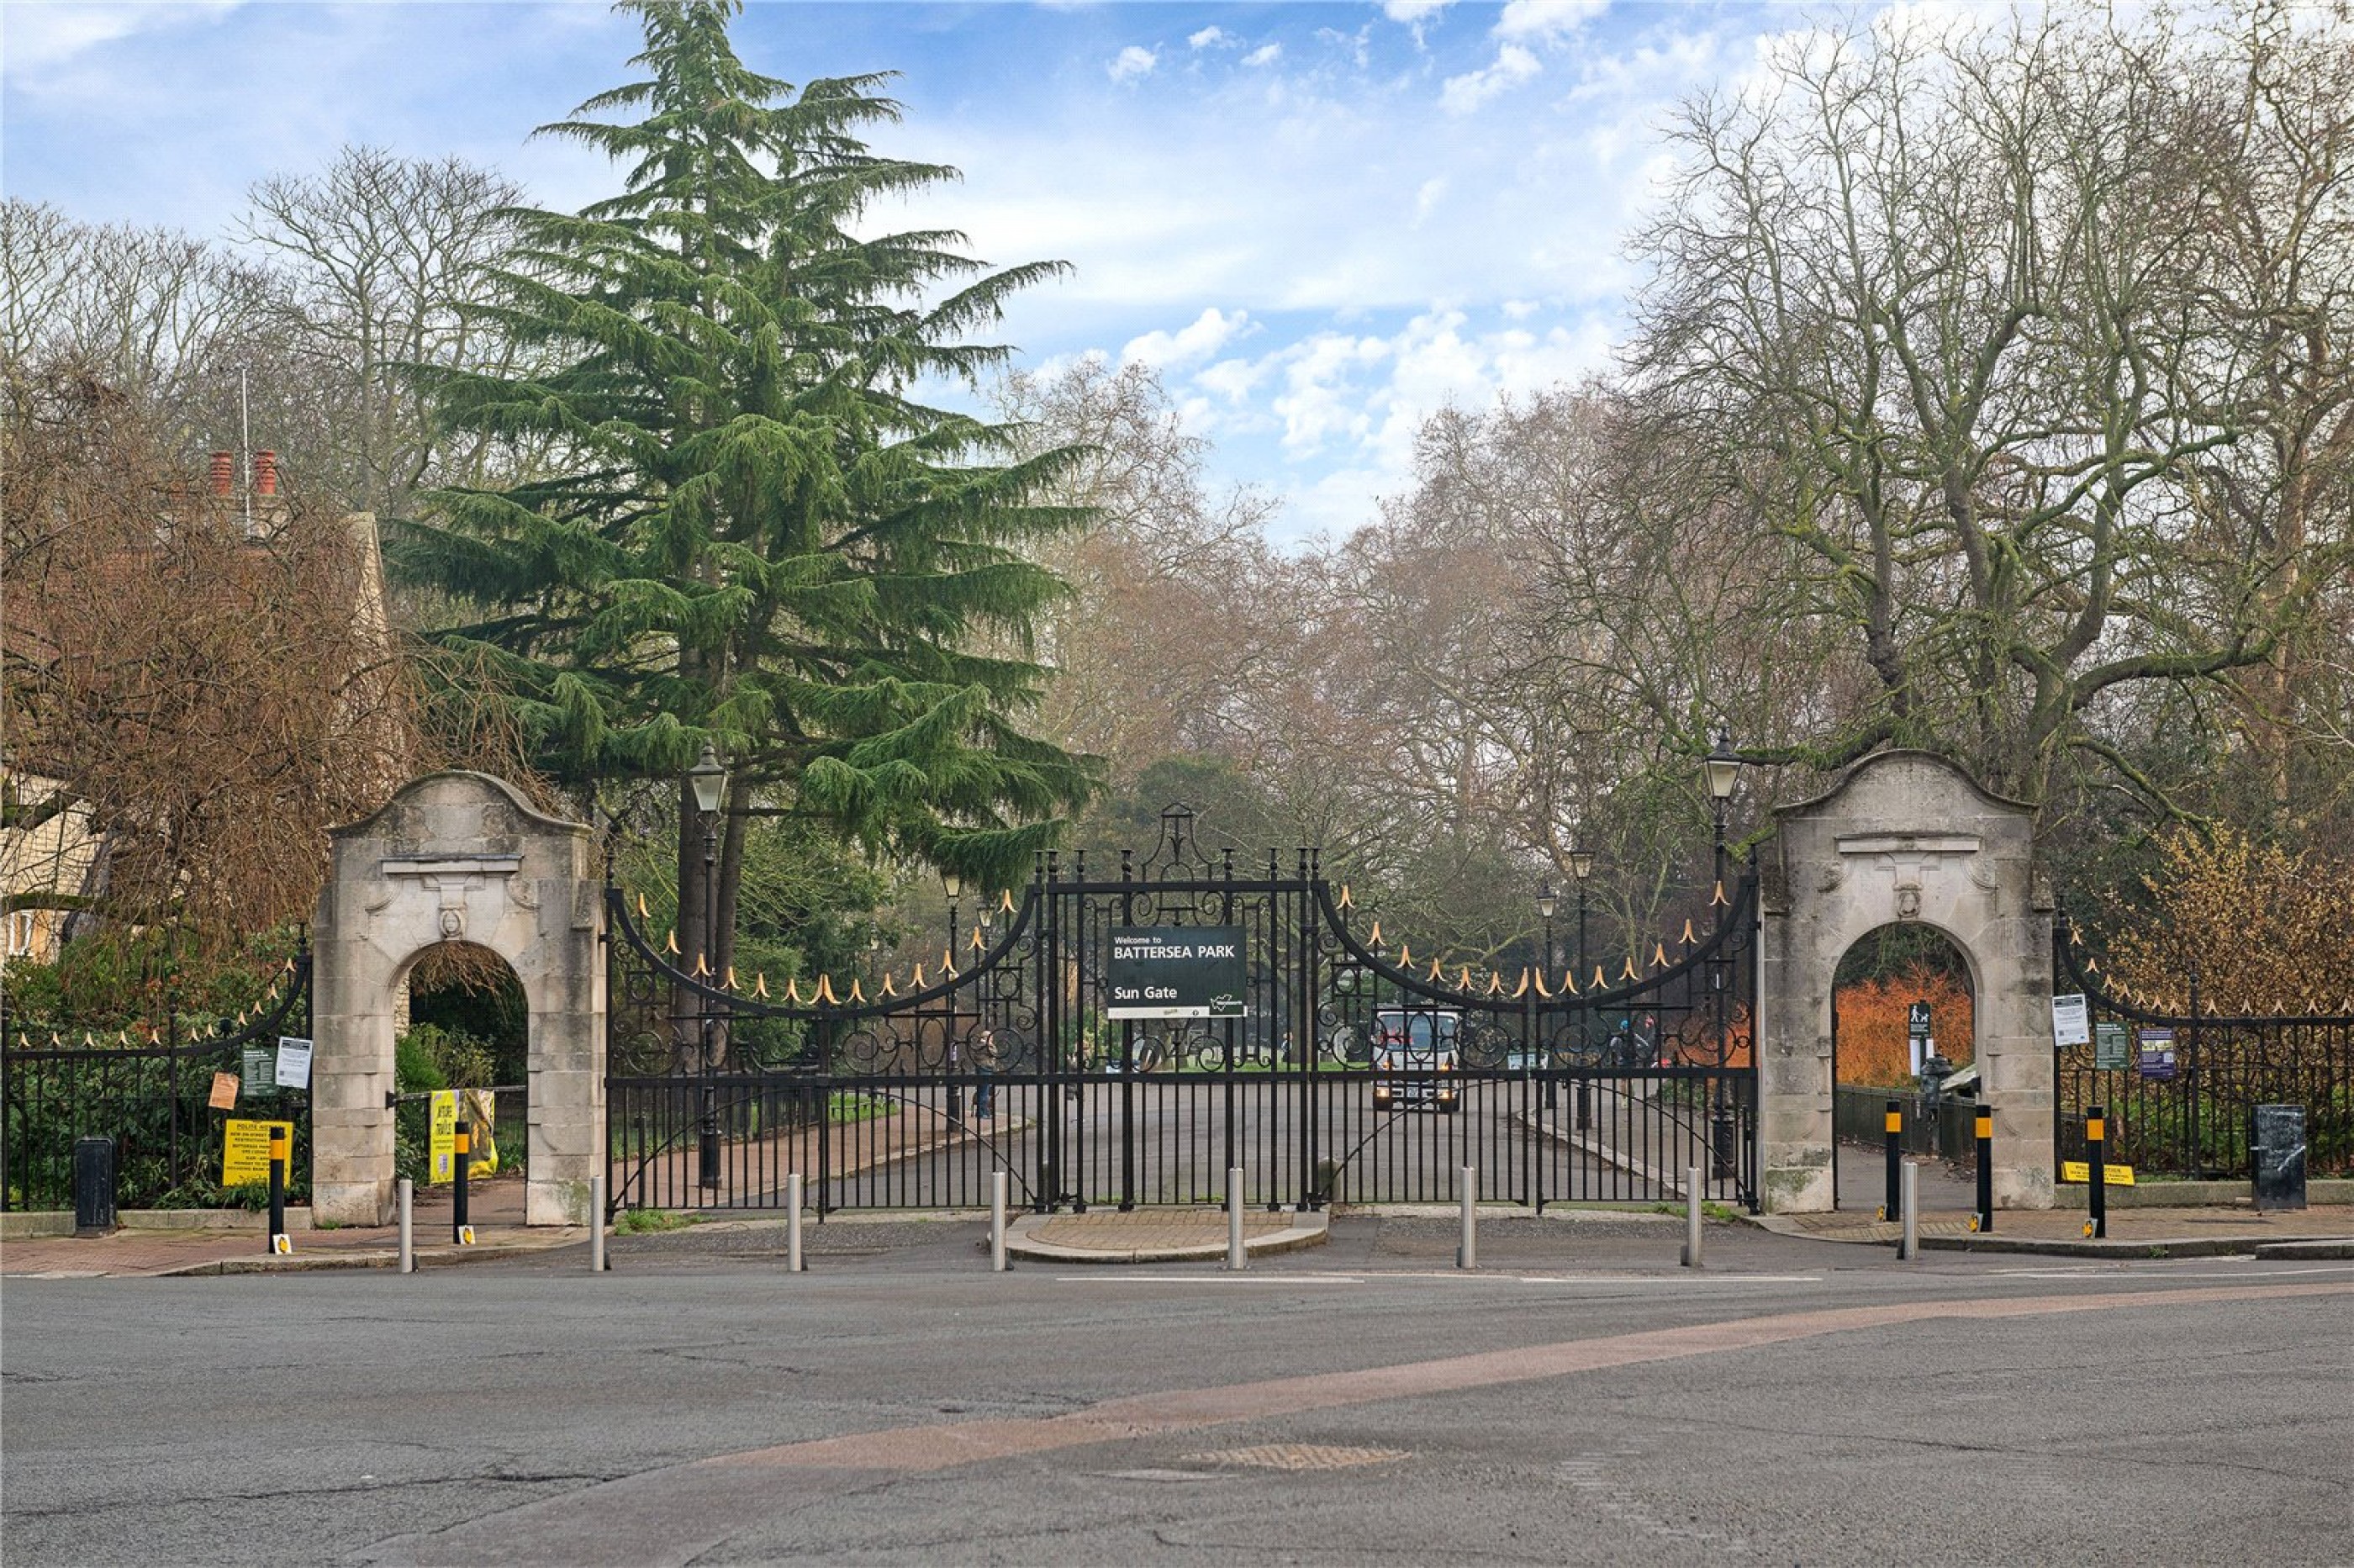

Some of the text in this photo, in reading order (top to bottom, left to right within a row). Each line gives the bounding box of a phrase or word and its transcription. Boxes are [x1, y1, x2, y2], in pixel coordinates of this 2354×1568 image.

[1114, 945, 1235, 959] BATTERSEA PARK
[1114, 986, 1177, 1000] Sun Gate
